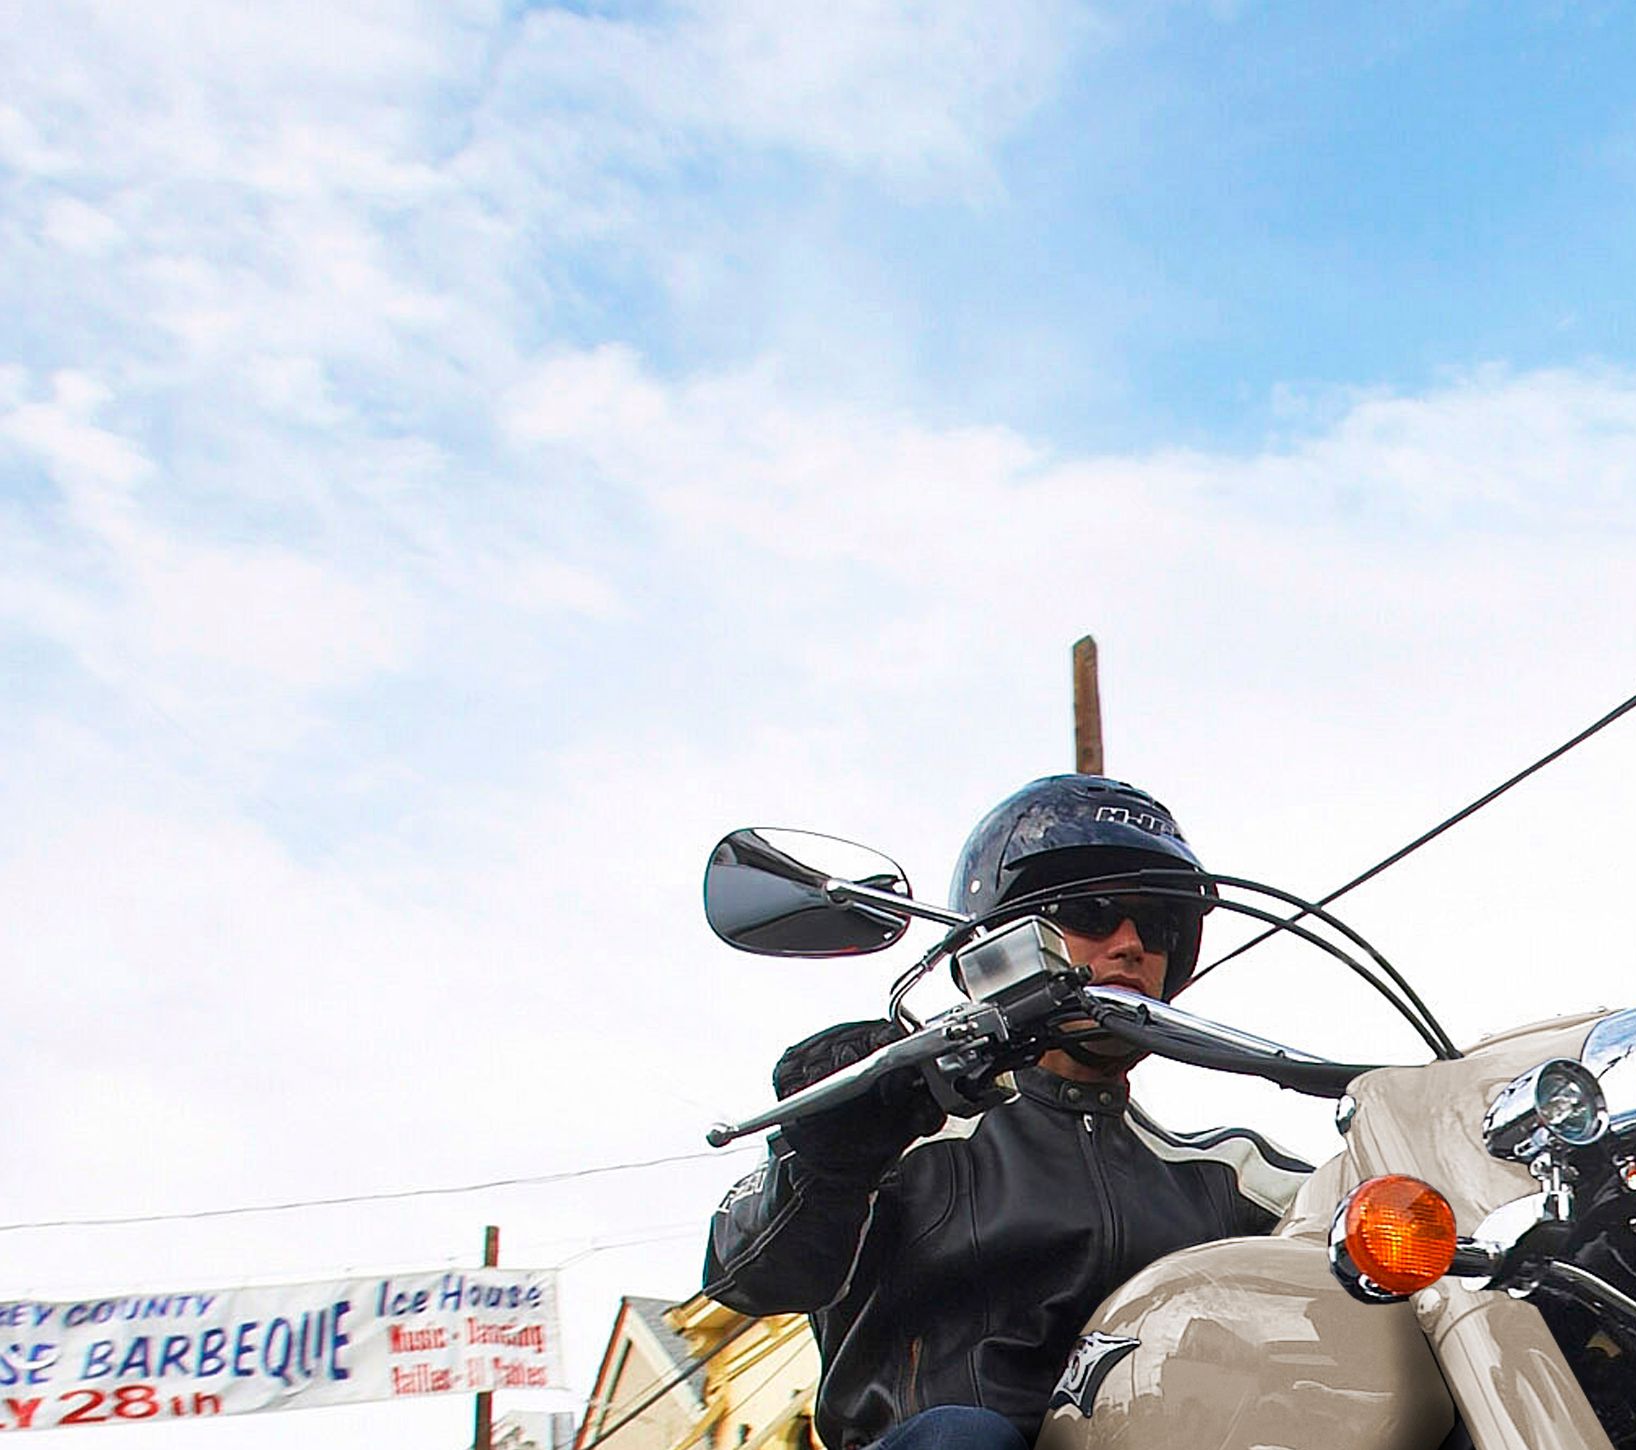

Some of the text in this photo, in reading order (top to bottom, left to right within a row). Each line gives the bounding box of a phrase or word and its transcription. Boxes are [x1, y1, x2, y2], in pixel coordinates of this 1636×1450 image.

[62, 1297, 214, 1327] COUNTY
[376, 1273, 542, 1317] Ice House
[80, 1300, 351, 1387] BARBEQUE
[0, 1397, 42, 1429] Y
